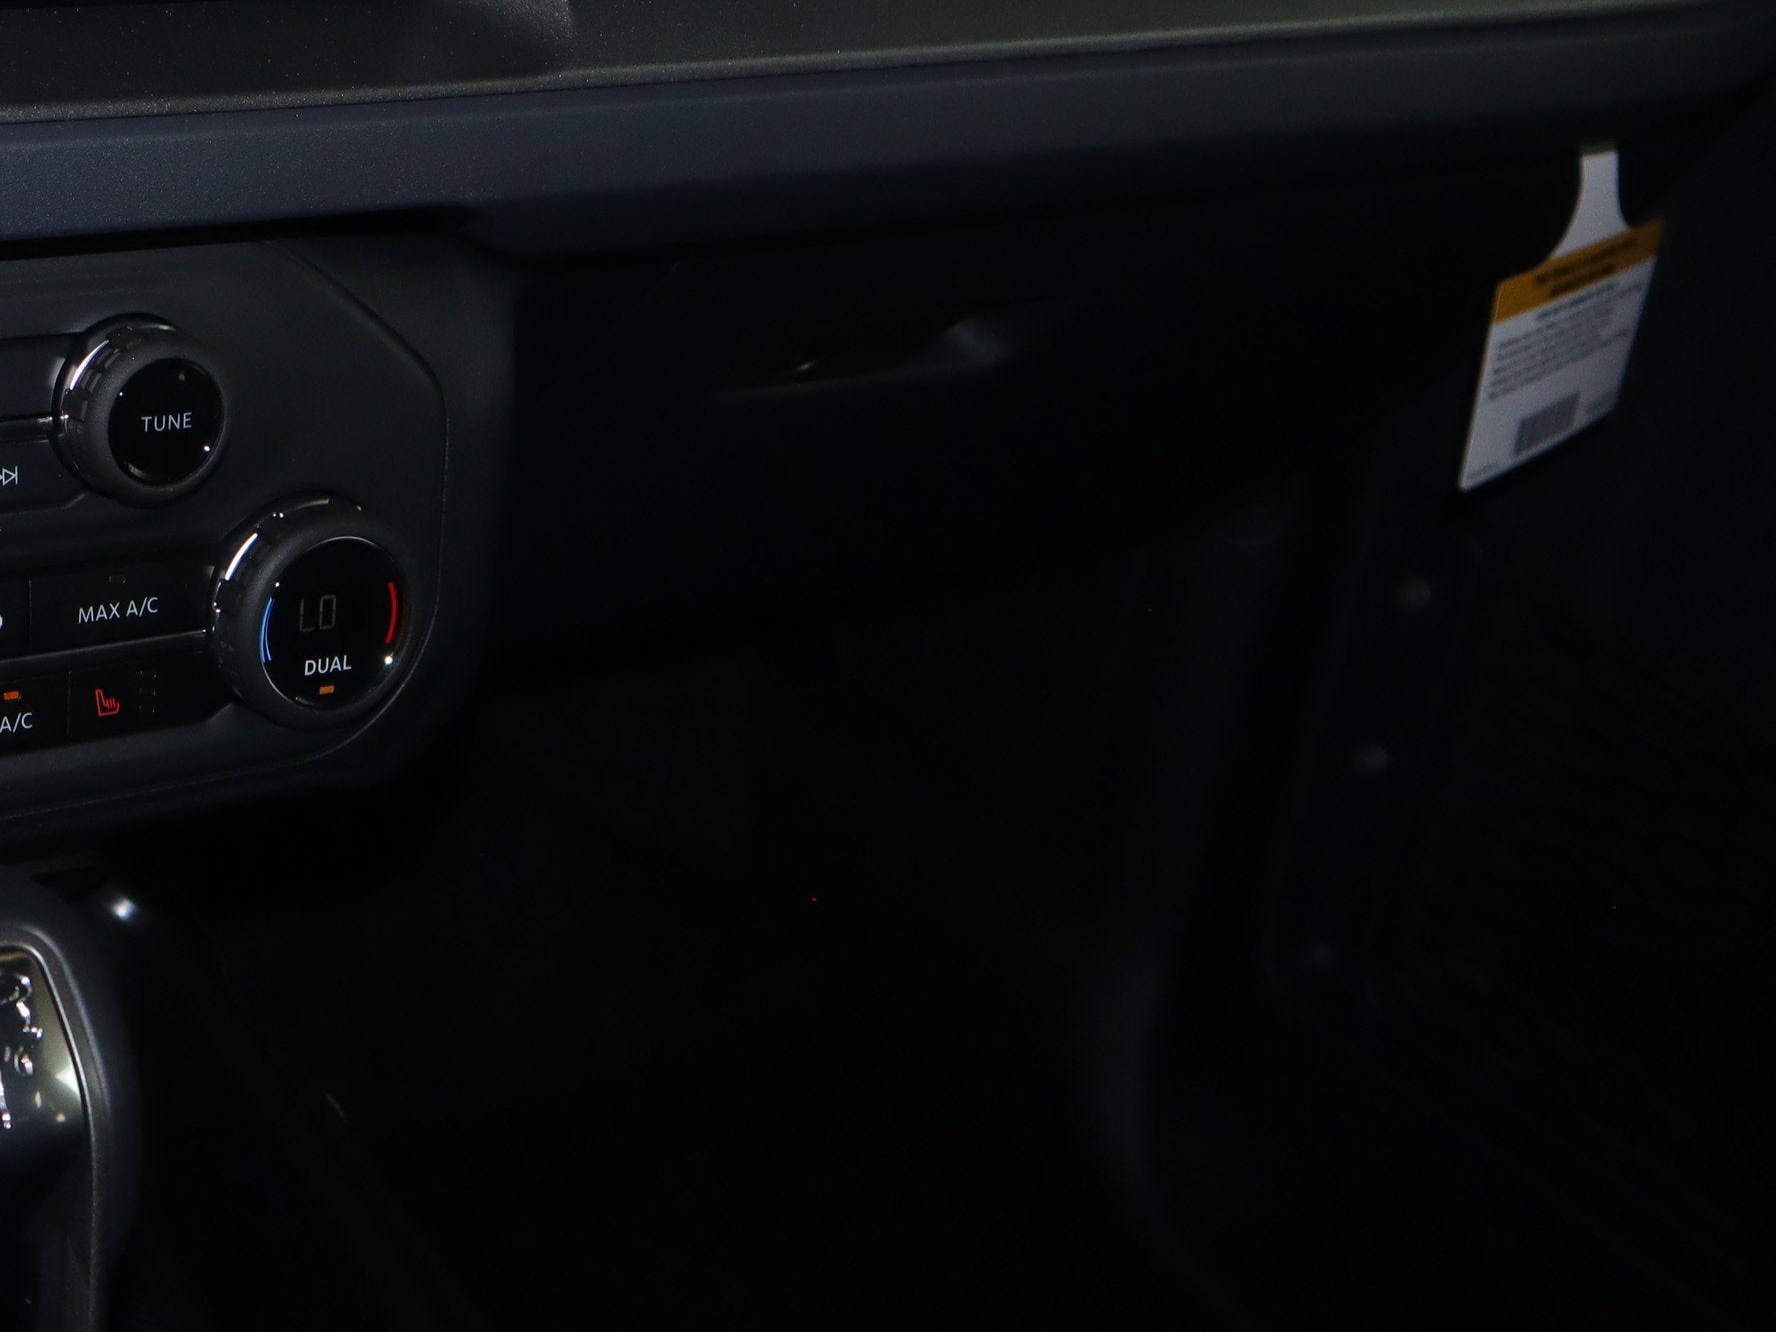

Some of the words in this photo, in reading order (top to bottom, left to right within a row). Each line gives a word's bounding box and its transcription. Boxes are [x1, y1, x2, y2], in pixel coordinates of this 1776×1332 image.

[141, 412, 193, 433] TUNE
[79, 602, 121, 624] MAX
[127, 598, 159, 617] A/C
[304, 655, 351, 677] DUAL
[0, 713, 33, 735] A/C
